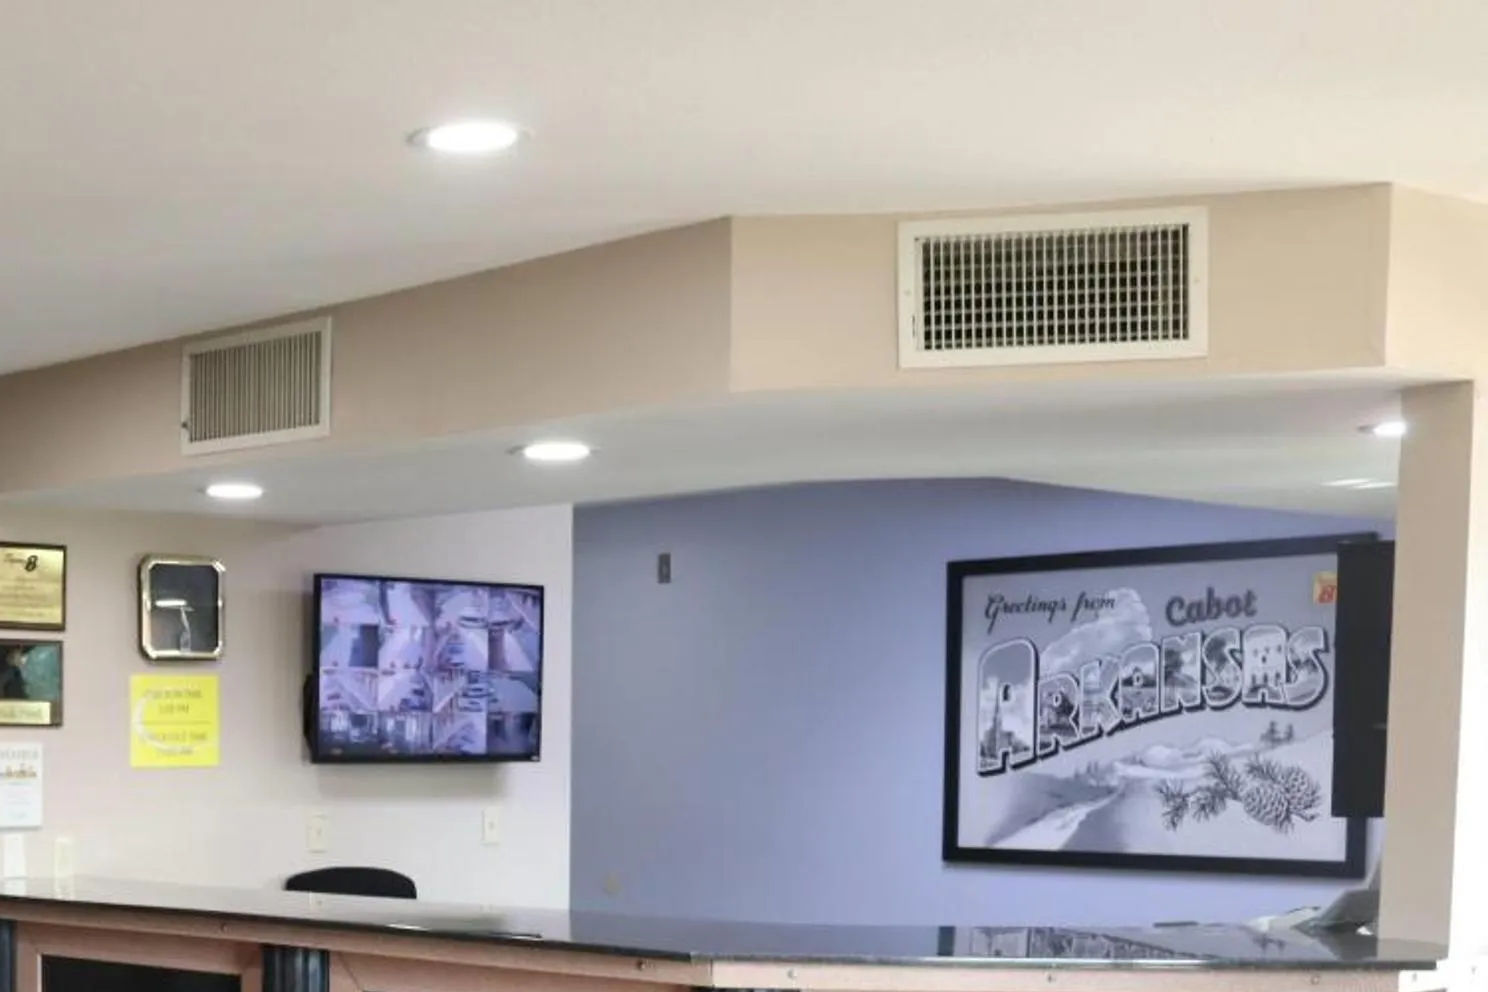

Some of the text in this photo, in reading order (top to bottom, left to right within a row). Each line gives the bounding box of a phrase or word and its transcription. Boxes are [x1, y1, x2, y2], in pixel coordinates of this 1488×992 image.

[24, 554, 39, 572] 8
[984, 585, 1259, 636] Greetings from Cabot
[977, 624, 1330, 778] ARKANSAS
